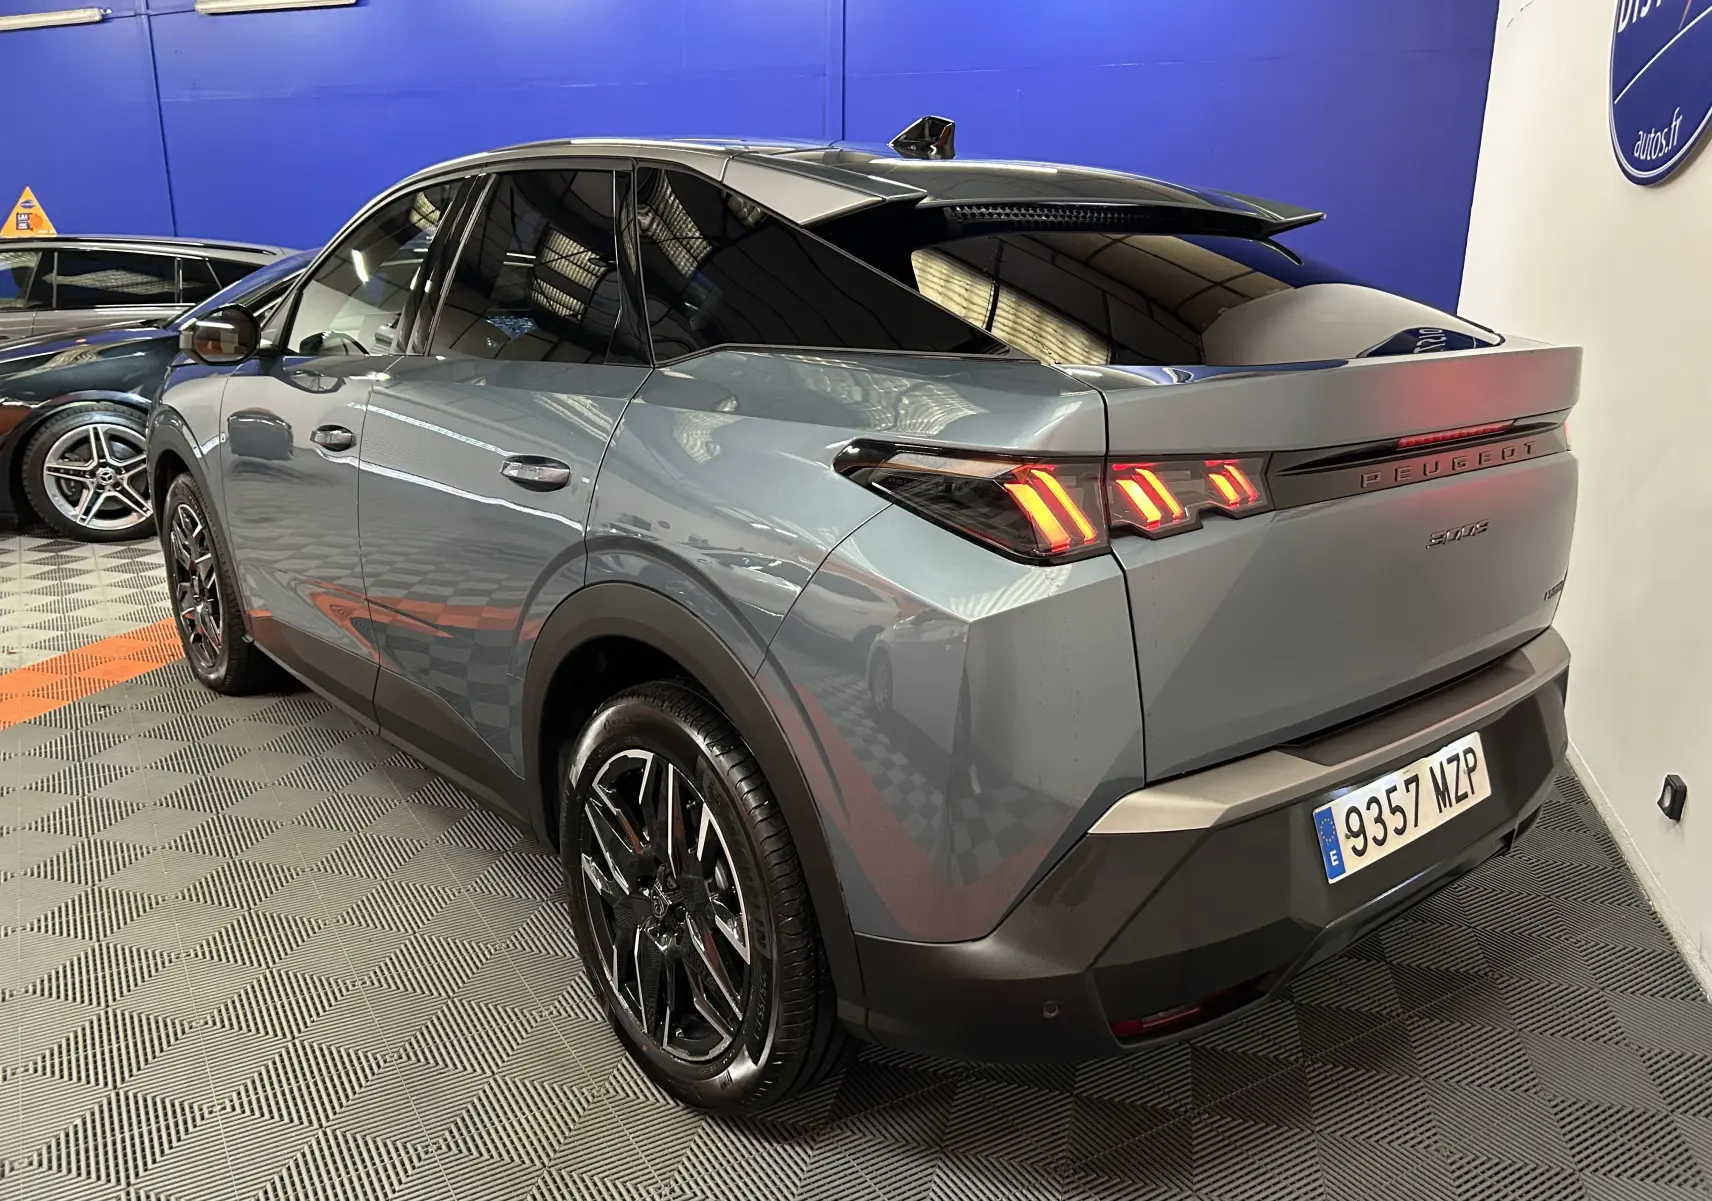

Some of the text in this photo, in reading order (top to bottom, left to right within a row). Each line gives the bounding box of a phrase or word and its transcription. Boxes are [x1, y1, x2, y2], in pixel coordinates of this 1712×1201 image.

[1633, 107, 1683, 160] autos.fr
[1361, 441, 1536, 488] PEUGEOT
[1345, 746, 1478, 857] 9357 MZP
[1329, 850, 1339, 867] E
